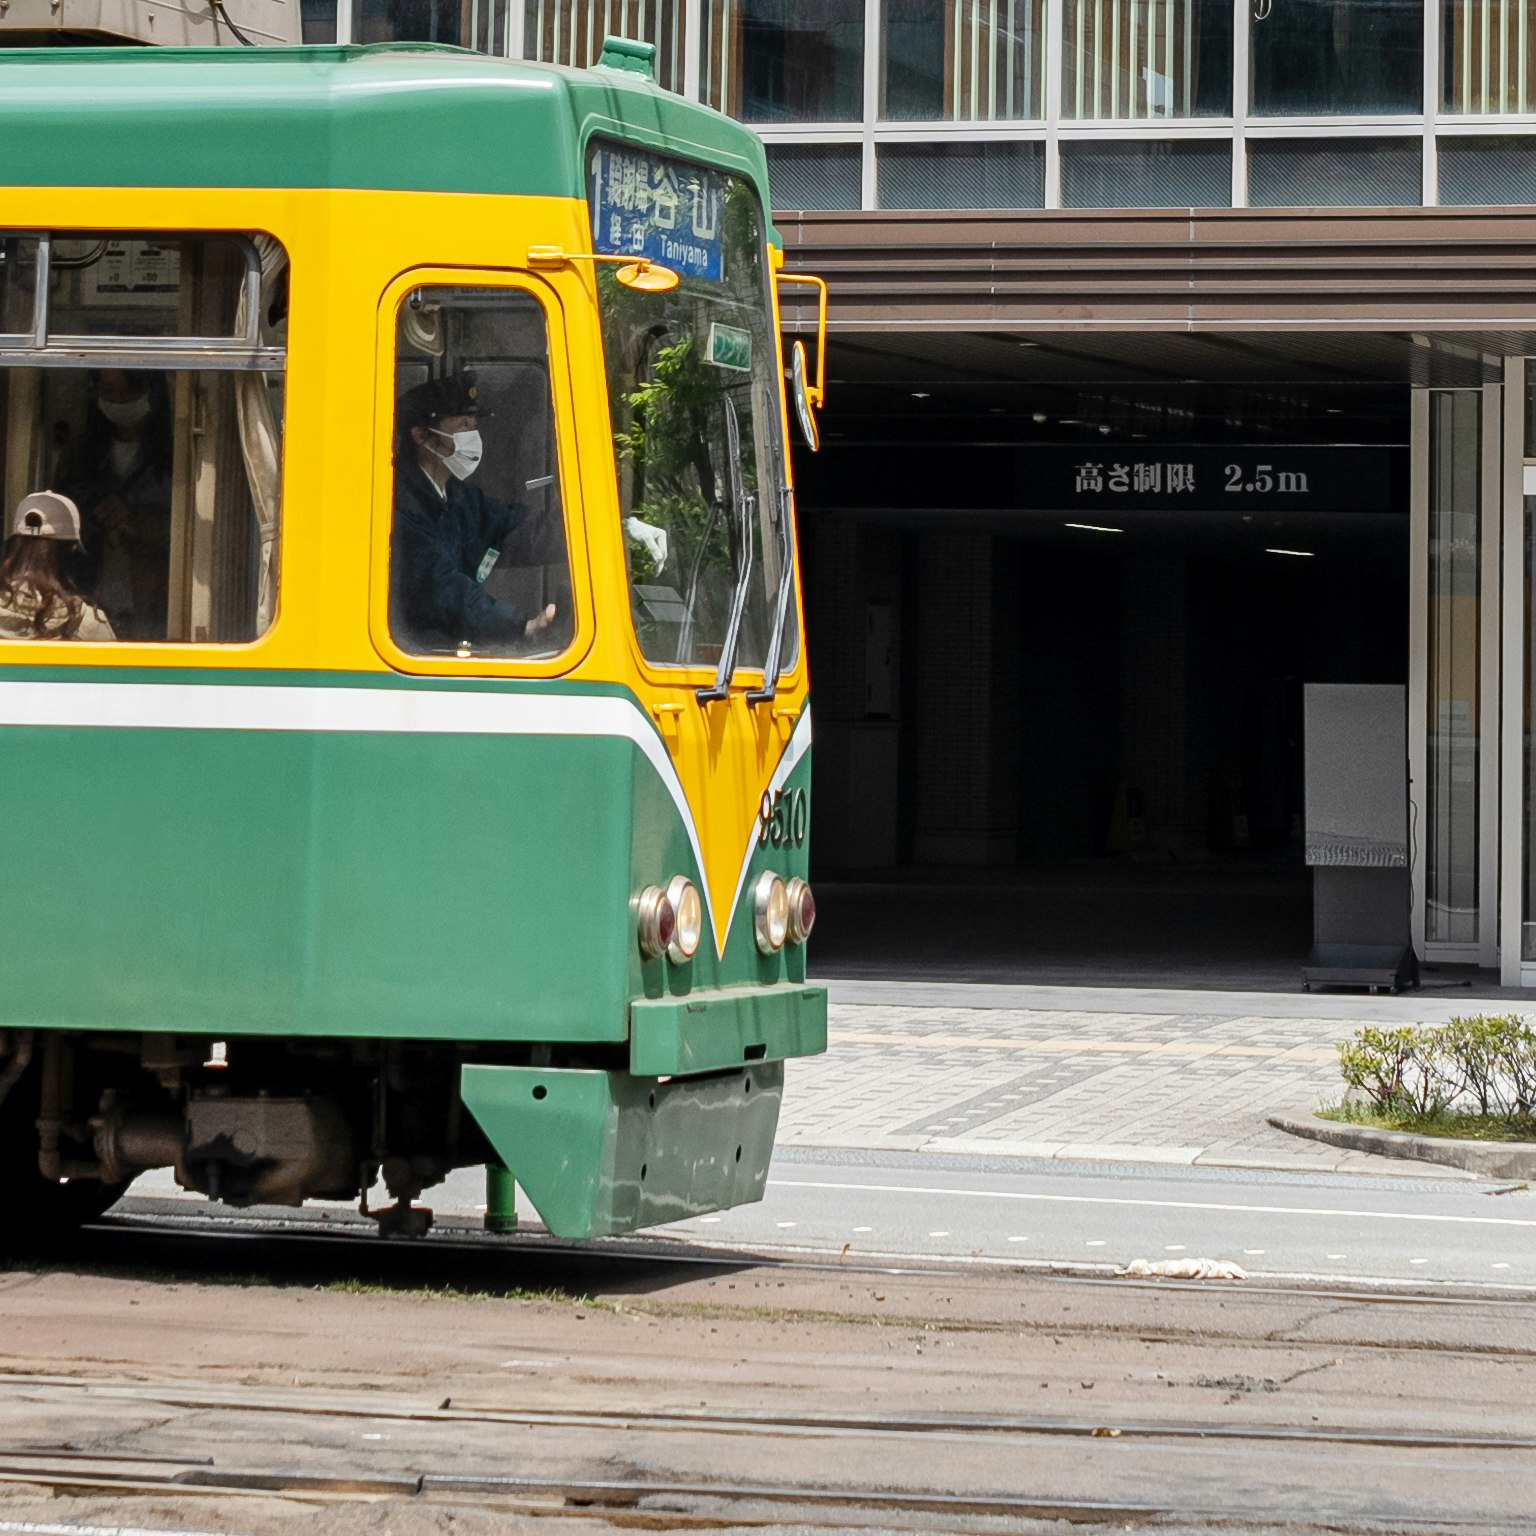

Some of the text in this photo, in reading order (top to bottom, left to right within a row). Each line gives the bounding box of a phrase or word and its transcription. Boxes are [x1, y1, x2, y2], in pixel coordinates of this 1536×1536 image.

[591, 149, 602, 240] 1
[651, 163, 718, 240] 谷山
[609, 211, 645, 251] 経由
[660, 235, 708, 266] Taniyama
[1075, 463, 1309, 493] 高さ制限 2.5m
